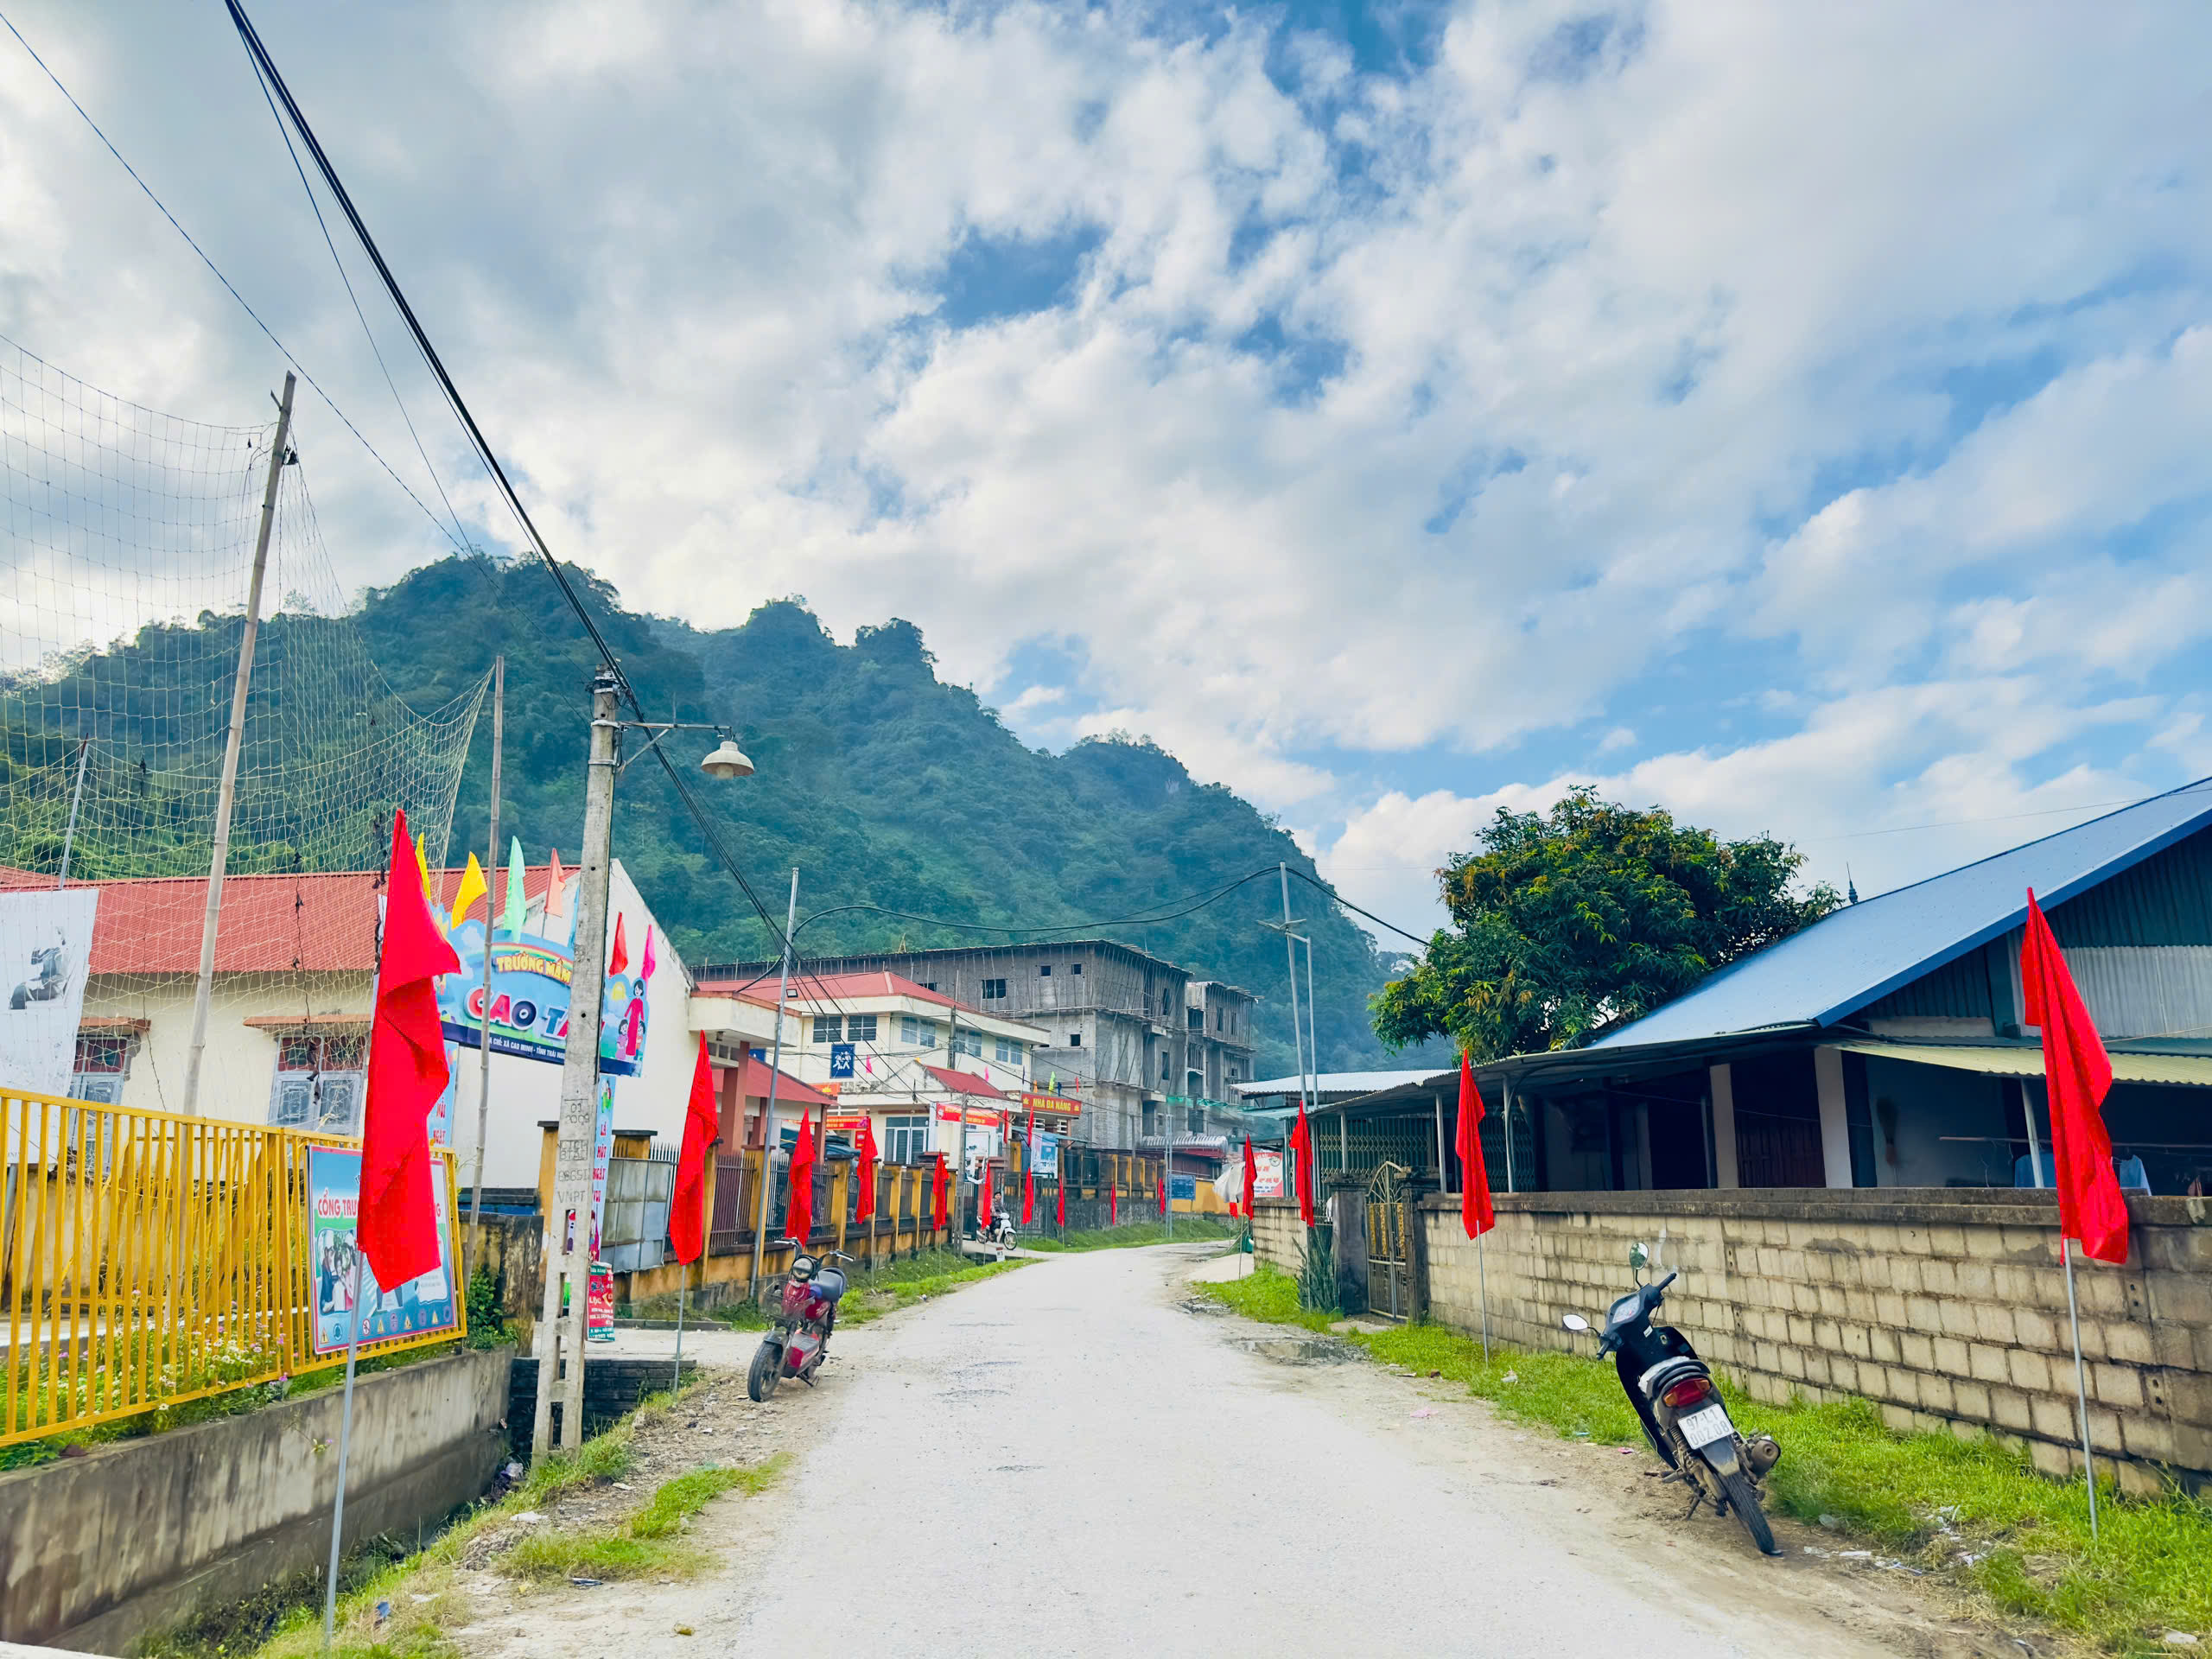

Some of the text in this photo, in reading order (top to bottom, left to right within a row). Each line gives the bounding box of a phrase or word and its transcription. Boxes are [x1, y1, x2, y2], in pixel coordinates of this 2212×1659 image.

[496, 950, 544, 974] TRƯỜNG
[467, 987, 537, 1028] CAO
[317, 1189, 340, 1217] CỔNG
[558, 1190, 585, 1203] VNPT
